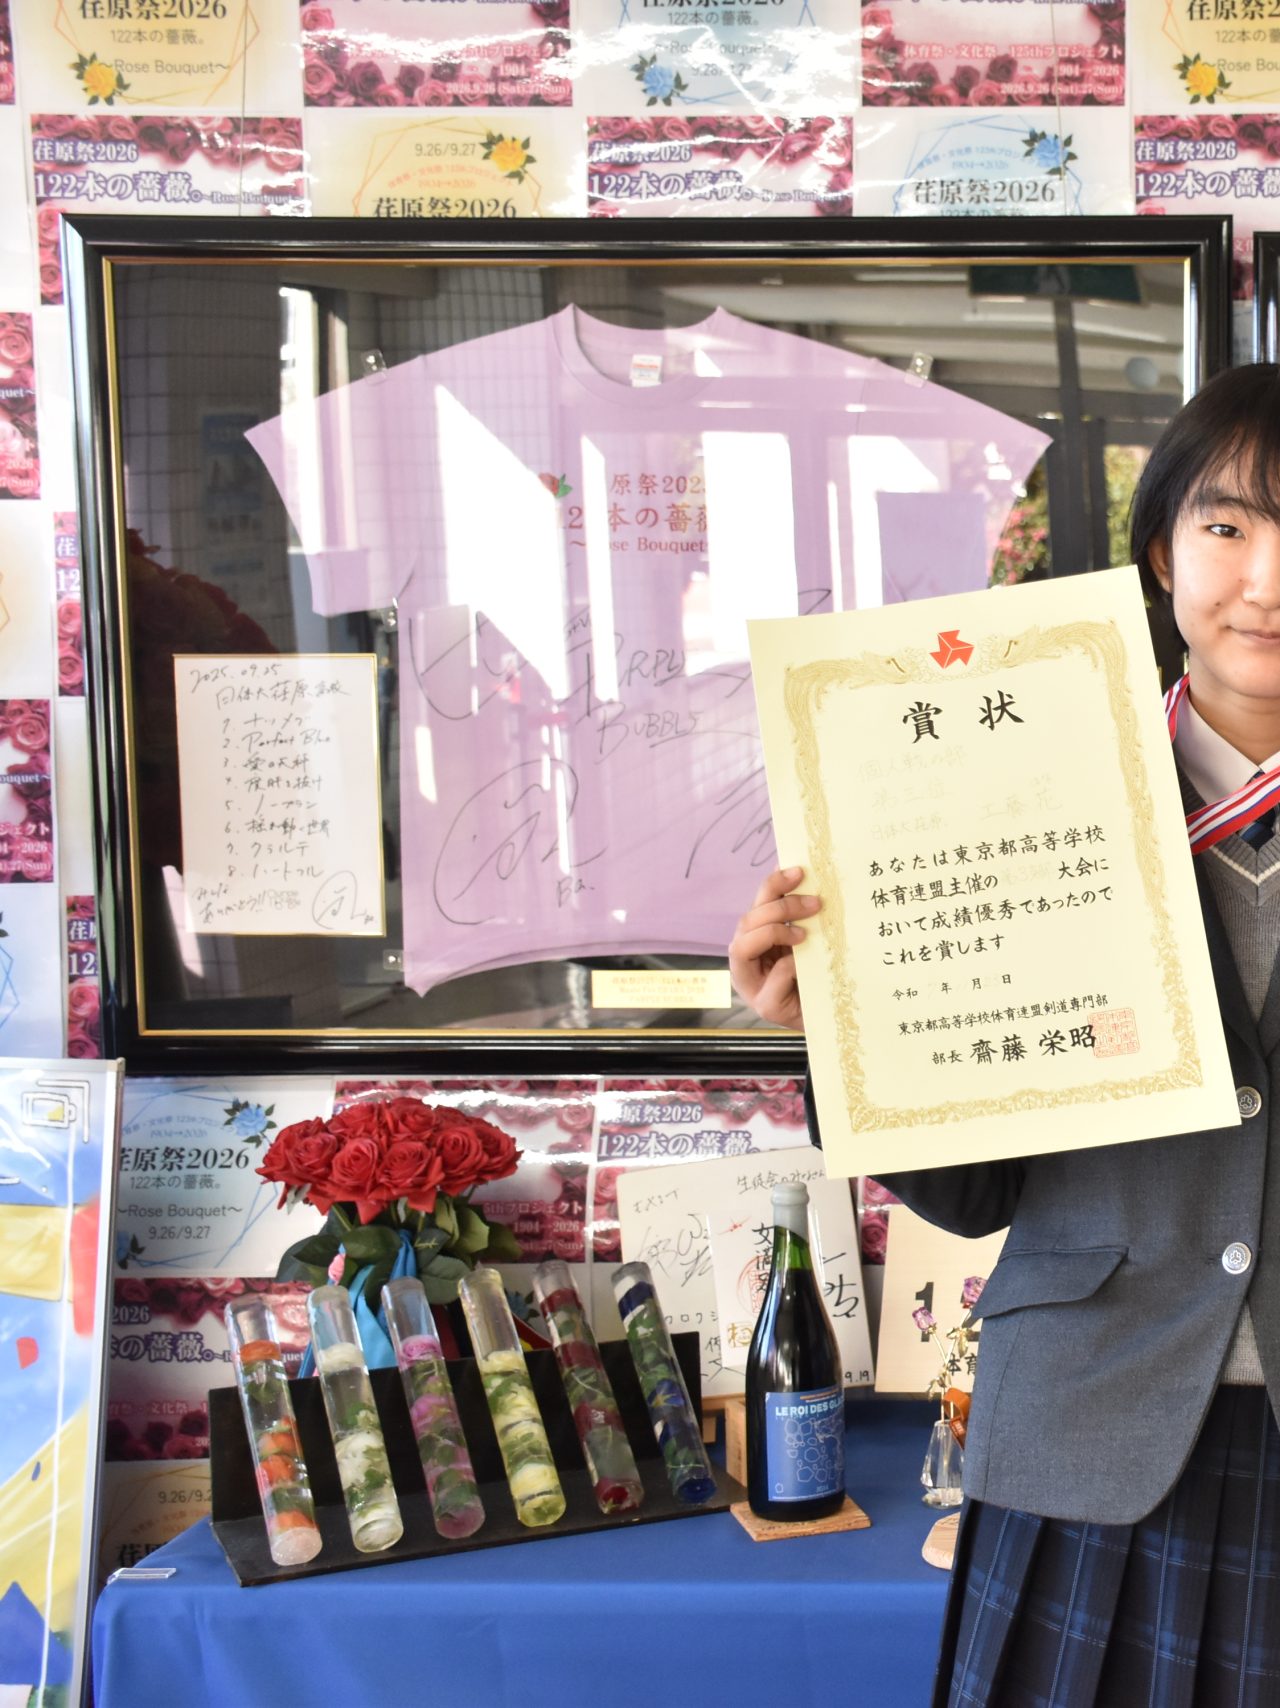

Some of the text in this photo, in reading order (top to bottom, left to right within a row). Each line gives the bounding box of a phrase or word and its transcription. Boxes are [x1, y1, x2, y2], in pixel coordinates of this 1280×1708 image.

[80, 0, 227, 20] 荏原祭2026
[668, 11, 760, 26] 122本の薔薇。
[111, 29, 204, 44] 122本の薔薇。
[33, 141, 138, 162] 荏原祭2026
[1136, 141, 1237, 162] 荏原祭2026
[34, 172, 201, 202] 122本の薔薇。
[637, 536, 706, 554] Bouquet
[869, 824, 1107, 877] あなたは東京都高等学校
[870, 872, 999, 909] 体育連盟主催の
[1058, 856, 1110, 880] 大会に
[878, 885, 1114, 937] おいて成績優秀であったので
[882, 933, 1005, 966] これを賞します
[892, 974, 1012, 1001] 令和 年 月 日
[899, 993, 1109, 1036] 東京都高等学校体育連盟剣道専門部
[931, 1049, 964, 1066] 部長
[130, 1174, 221, 1190] 122本の薔薇。
[775, 1406, 789, 1417] LE
[790, 1405, 809, 1416] ROI
[158, 1489, 211, 1504] 9.26/9.2
